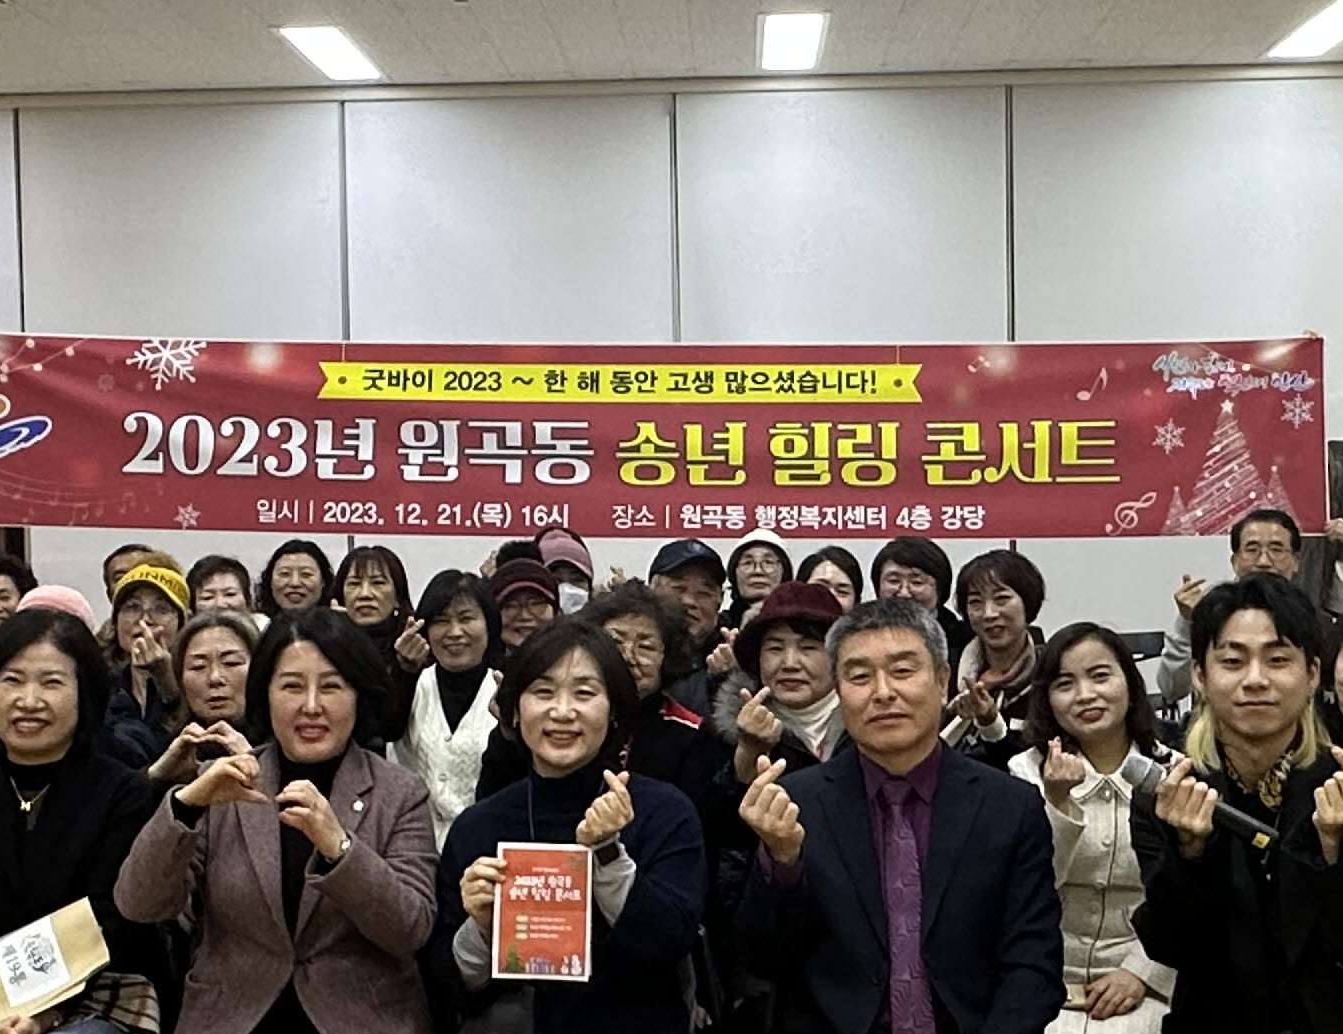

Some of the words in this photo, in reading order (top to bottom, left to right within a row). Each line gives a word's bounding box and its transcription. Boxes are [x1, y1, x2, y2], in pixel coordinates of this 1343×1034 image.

[362, 368, 434, 393] 굿바이
[443, 370, 503, 392] 2023
[544, 369, 568, 394] 한
[577, 369, 601, 394] 해
[610, 370, 659, 394] 동안
[666, 370, 715, 394] 고생
[725, 370, 877, 394] 많으셨습니다!
[121, 411, 376, 482] 2023년
[396, 418, 595, 485] 원곡동
[615, 421, 747, 487] 송년
[769, 421, 900, 487] 힐링
[921, 420, 1121, 486] 콘서트
[256, 500, 299, 524] 일시
[323, 501, 385, 525] 2023.
[395, 502, 428, 526] 12.
[437, 502, 512, 528] 21.(목)
[521, 503, 570, 528] 16시
[611, 504, 657, 529] 장소
[680, 504, 747, 530] 원곡동
[755, 504, 887, 530] 행정복지센터
[895, 505, 932, 530] 4층
[941, 505, 986, 530] 강당
